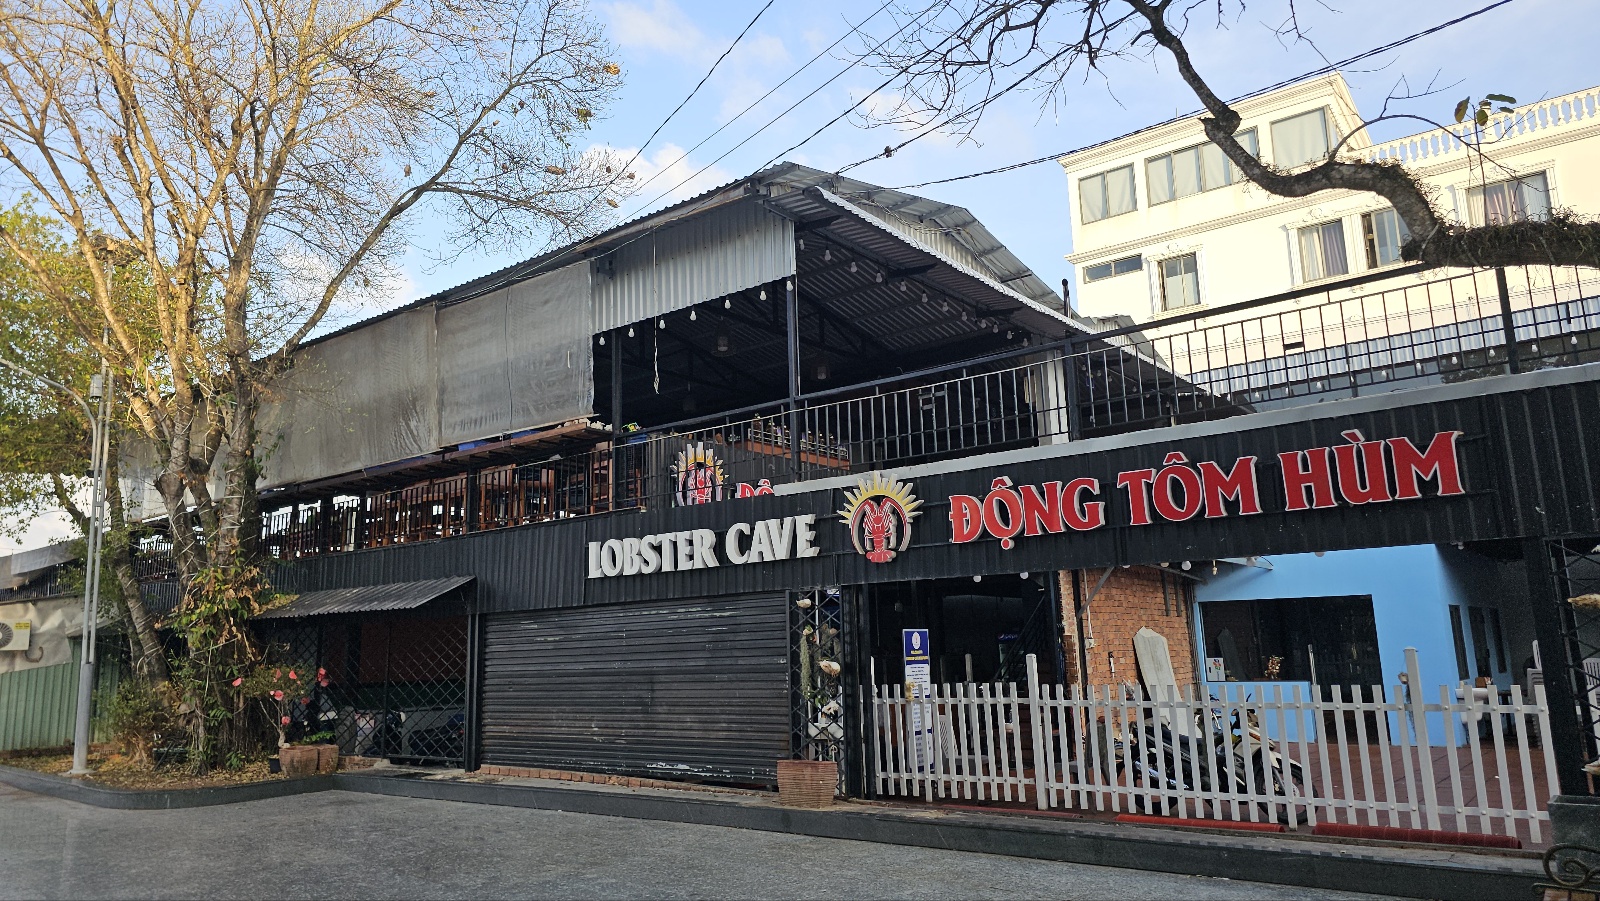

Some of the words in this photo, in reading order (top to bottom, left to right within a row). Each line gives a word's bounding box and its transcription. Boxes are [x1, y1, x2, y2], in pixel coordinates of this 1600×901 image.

[949, 476, 1105, 549] ĐỘNG
[1117, 451, 1263, 525] TÔM
[1277, 429, 1466, 511] HÙM
[588, 528, 720, 578] LOBSTER
[725, 514, 820, 564] CAVE
